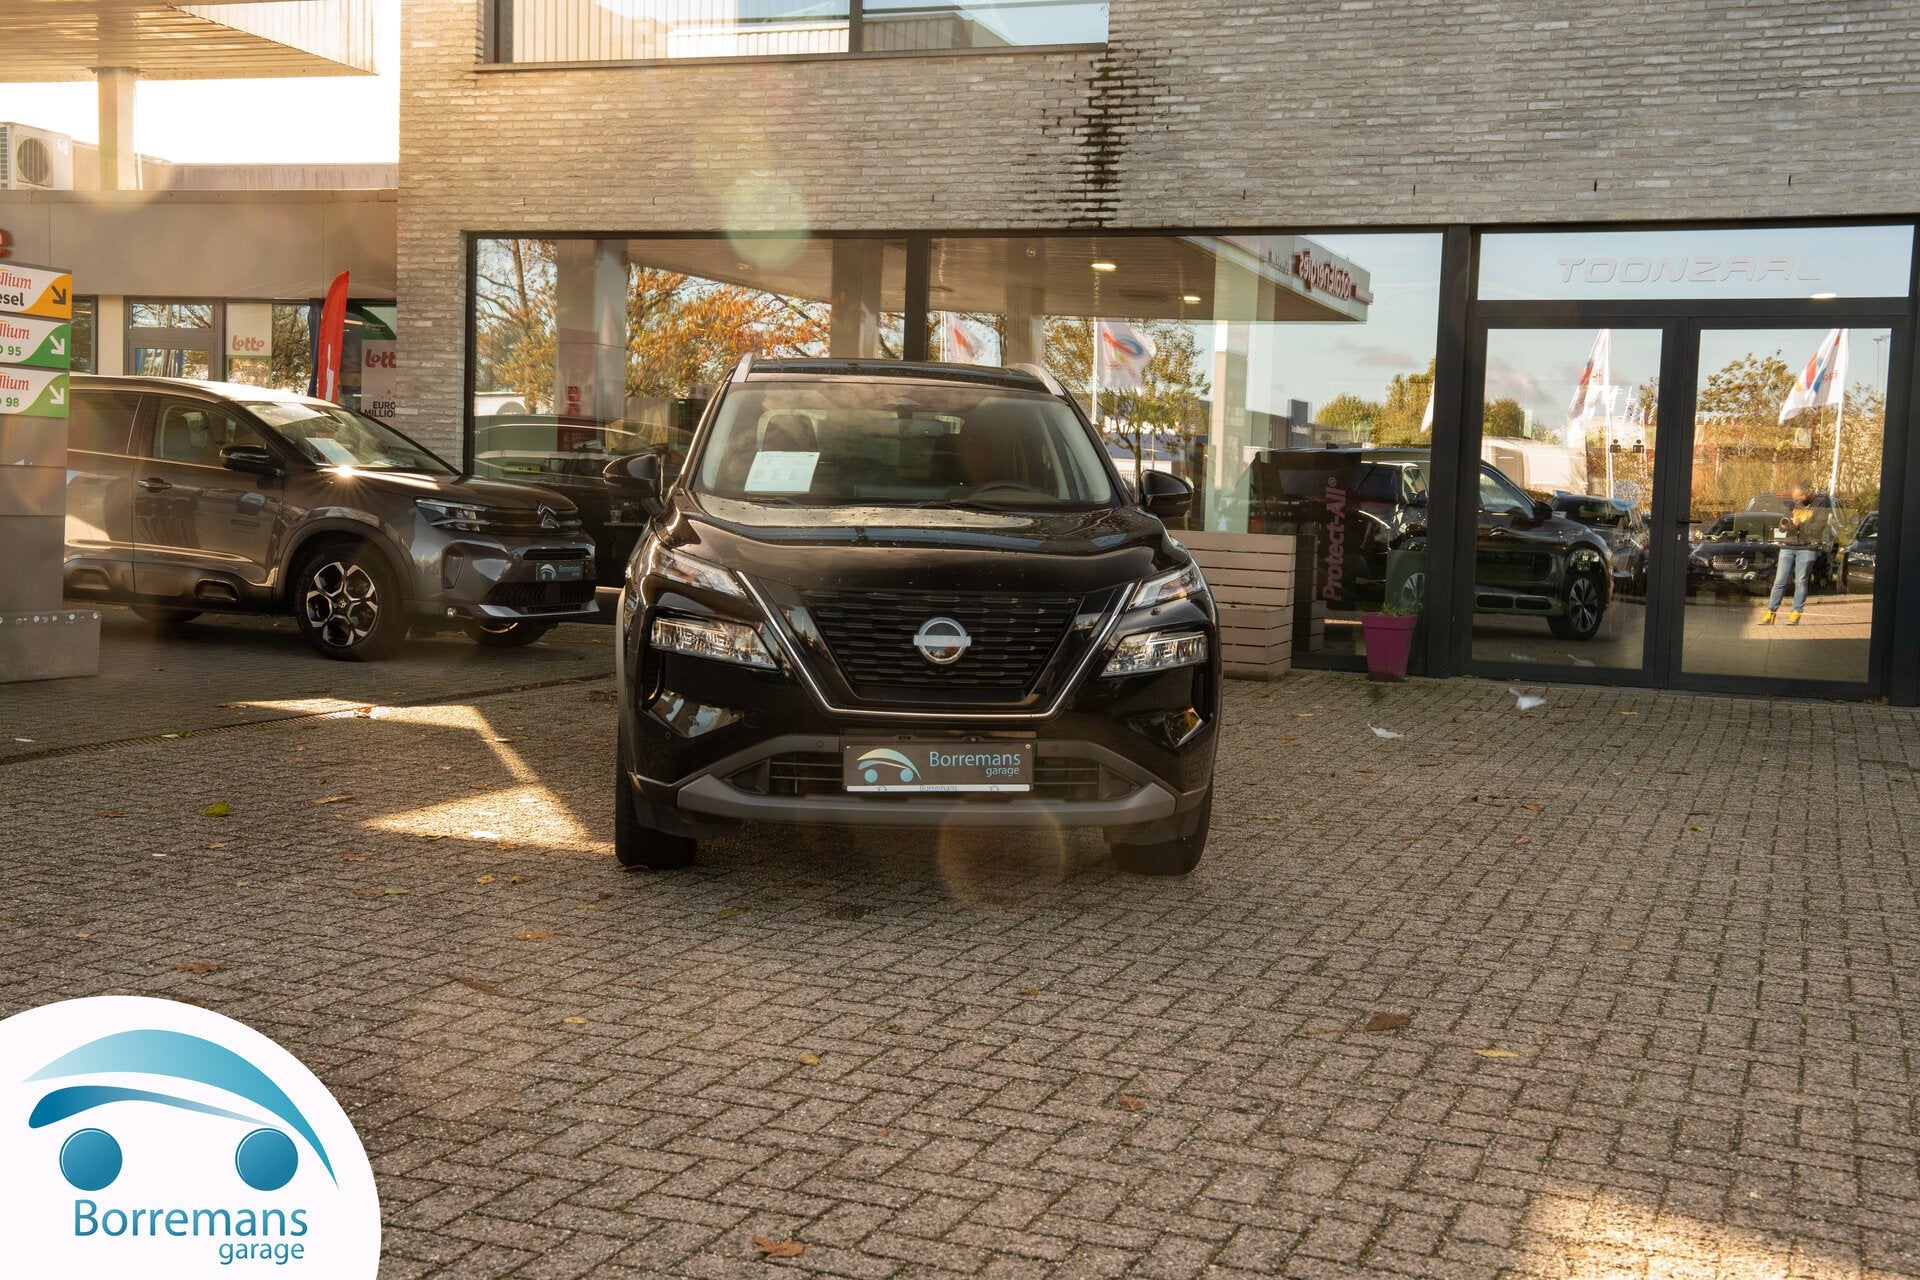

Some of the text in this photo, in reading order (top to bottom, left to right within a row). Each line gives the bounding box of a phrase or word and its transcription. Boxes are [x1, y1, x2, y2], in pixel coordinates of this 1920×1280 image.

[1557, 256, 1821, 283] TOONZAAL
[0, 271, 32, 289] llium
[7, 345, 22, 356] 95
[5, 396, 20, 407] 98
[372, 401, 396, 410] EURO
[364, 408, 396, 418] MILLIO
[929, 751, 1021, 767] Borremans
[985, 768, 1020, 777] garage
